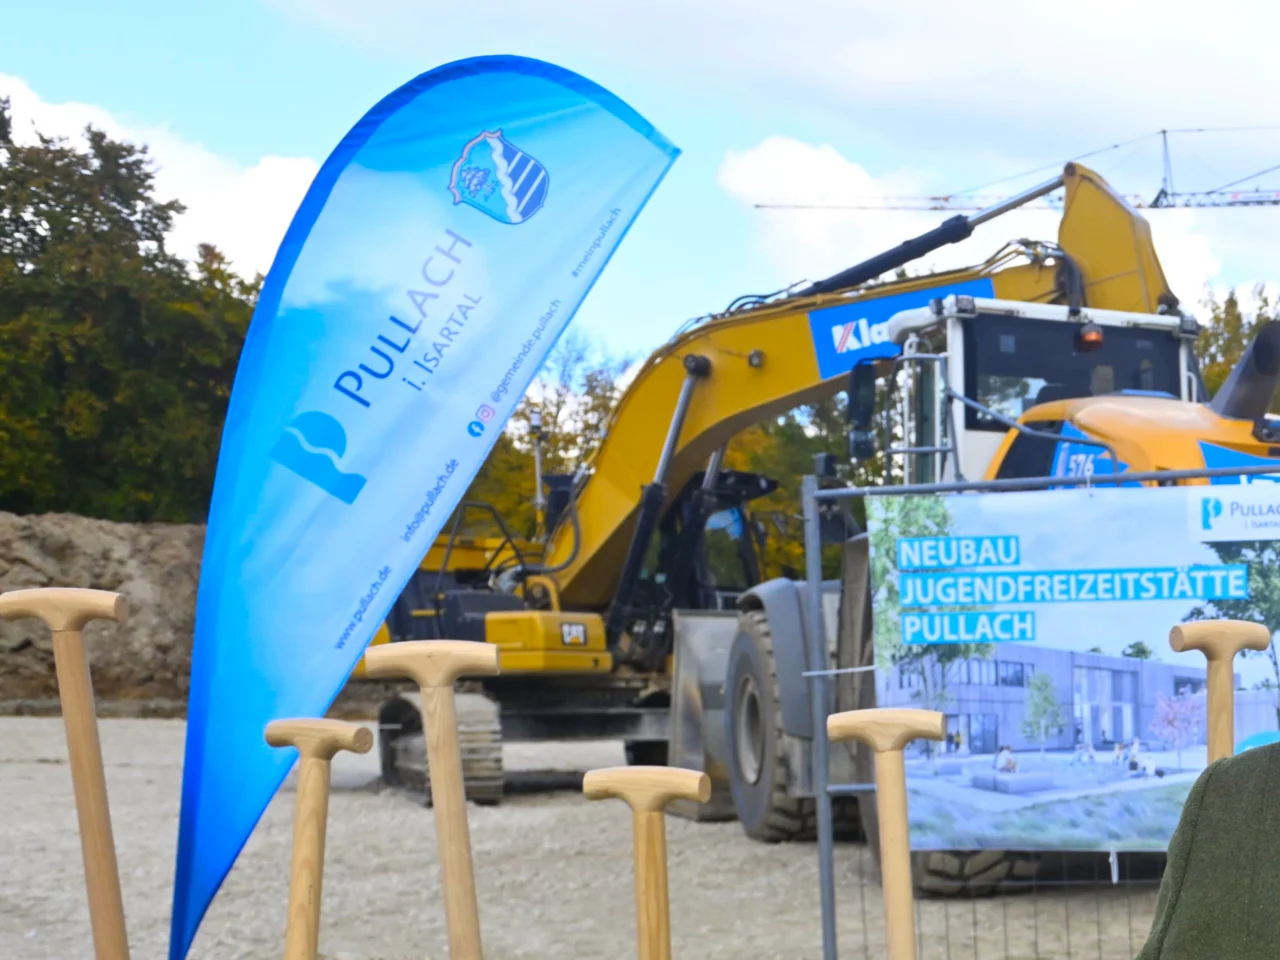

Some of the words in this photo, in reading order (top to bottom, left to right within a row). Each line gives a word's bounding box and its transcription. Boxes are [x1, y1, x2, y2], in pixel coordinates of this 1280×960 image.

[571, 207, 622, 279] #meinpullach
[333, 228, 473, 408] PULLACH
[413, 294, 482, 374] ISARTAL
[490, 298, 562, 403] @gemeinde.pullach
[402, 377, 426, 391] i.
[400, 457, 460, 543] info@pullach.de
[901, 538, 1018, 566] NEUBAU
[901, 567, 1246, 604] JUGENDFREIZEITSTÄTTE
[335, 564, 393, 650] www.pullach.de
[904, 613, 1034, 642] PULLACH
